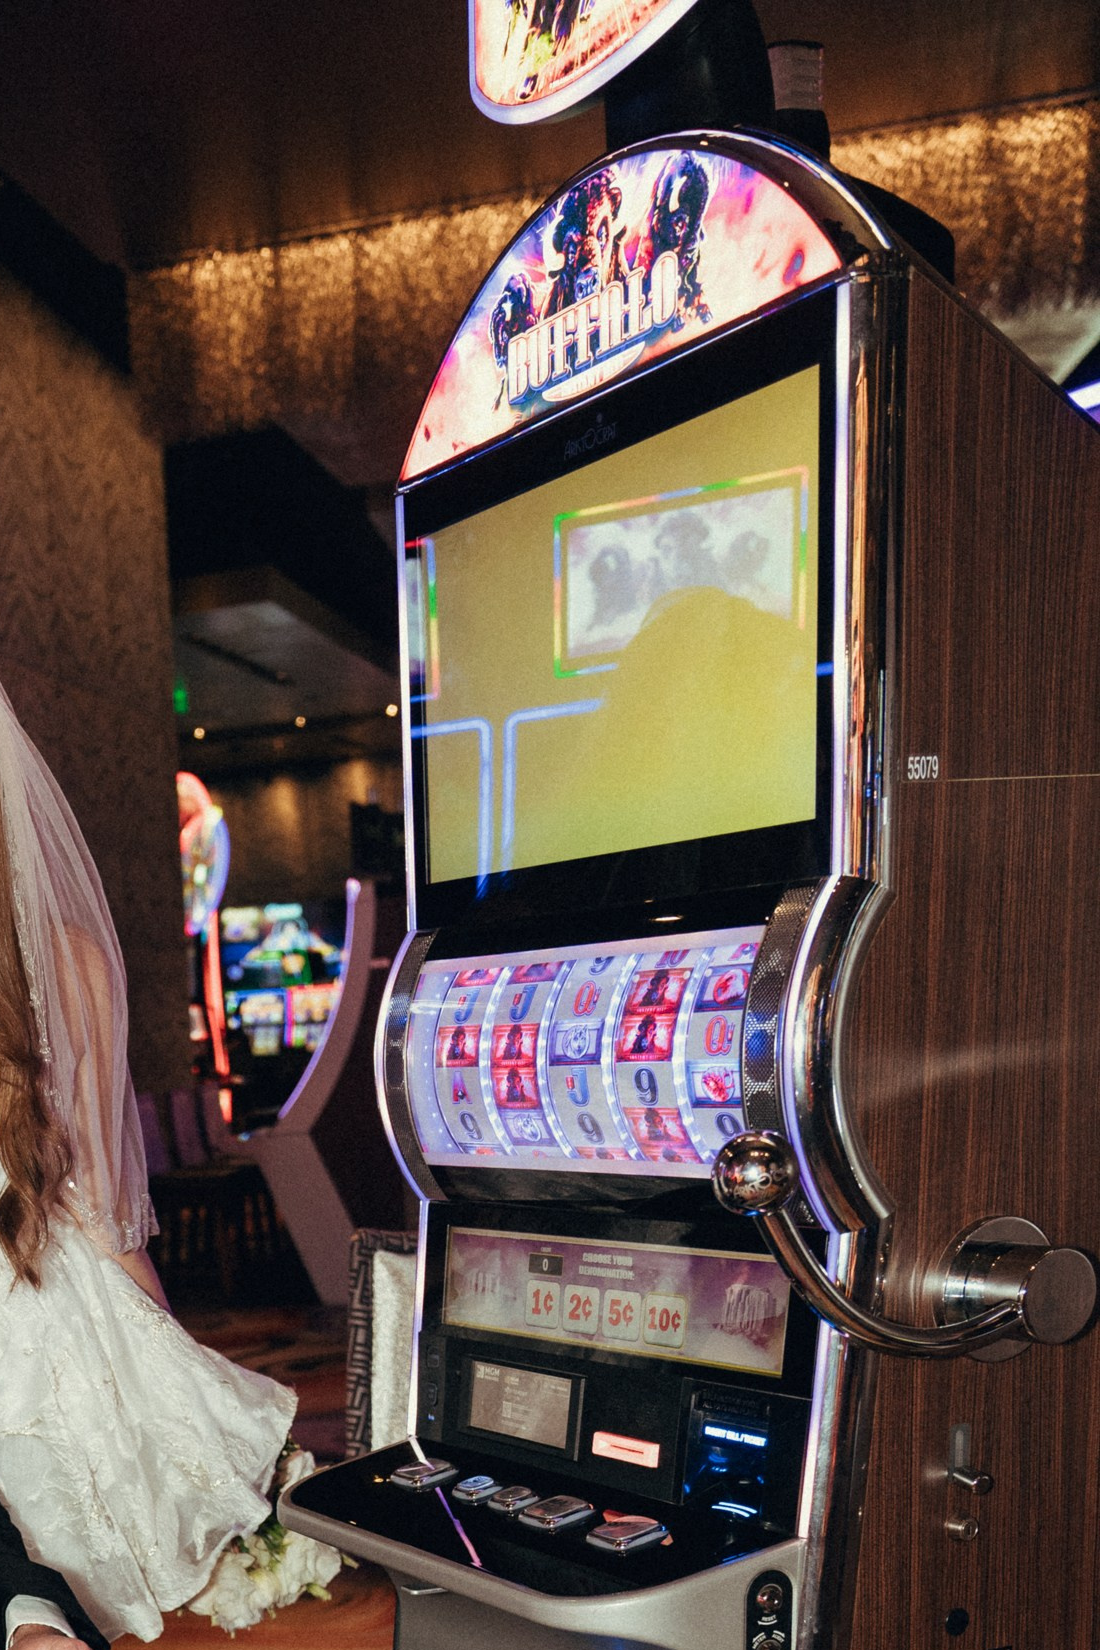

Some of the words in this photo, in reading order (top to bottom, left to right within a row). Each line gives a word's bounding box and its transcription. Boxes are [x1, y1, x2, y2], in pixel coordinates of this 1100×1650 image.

[509, 250, 682, 404] BUFFALO
[907, 755, 939, 780] 55079
[454, 988, 481, 1024] J
[509, 984, 539, 1022] J
[573, 981, 601, 1016] Q
[704, 1014, 734, 1056] Q
[452, 1071, 473, 1105] A
[566, 1068, 590, 1107] J
[633, 1066, 660, 1106] 9
[460, 1110, 485, 1141] 9
[577, 1111, 605, 1144] 9
[542, 1258, 549, 1272] 0
[582, 1252, 612, 1265] CHOOSE
[532, 1288, 554, 1317] 1¢
[567, 1293, 593, 1322] 2¢
[607, 1298, 634, 1328] 5¢
[647, 1306, 681, 1333] 10¢
[485, 1366, 500, 1377] MGM
